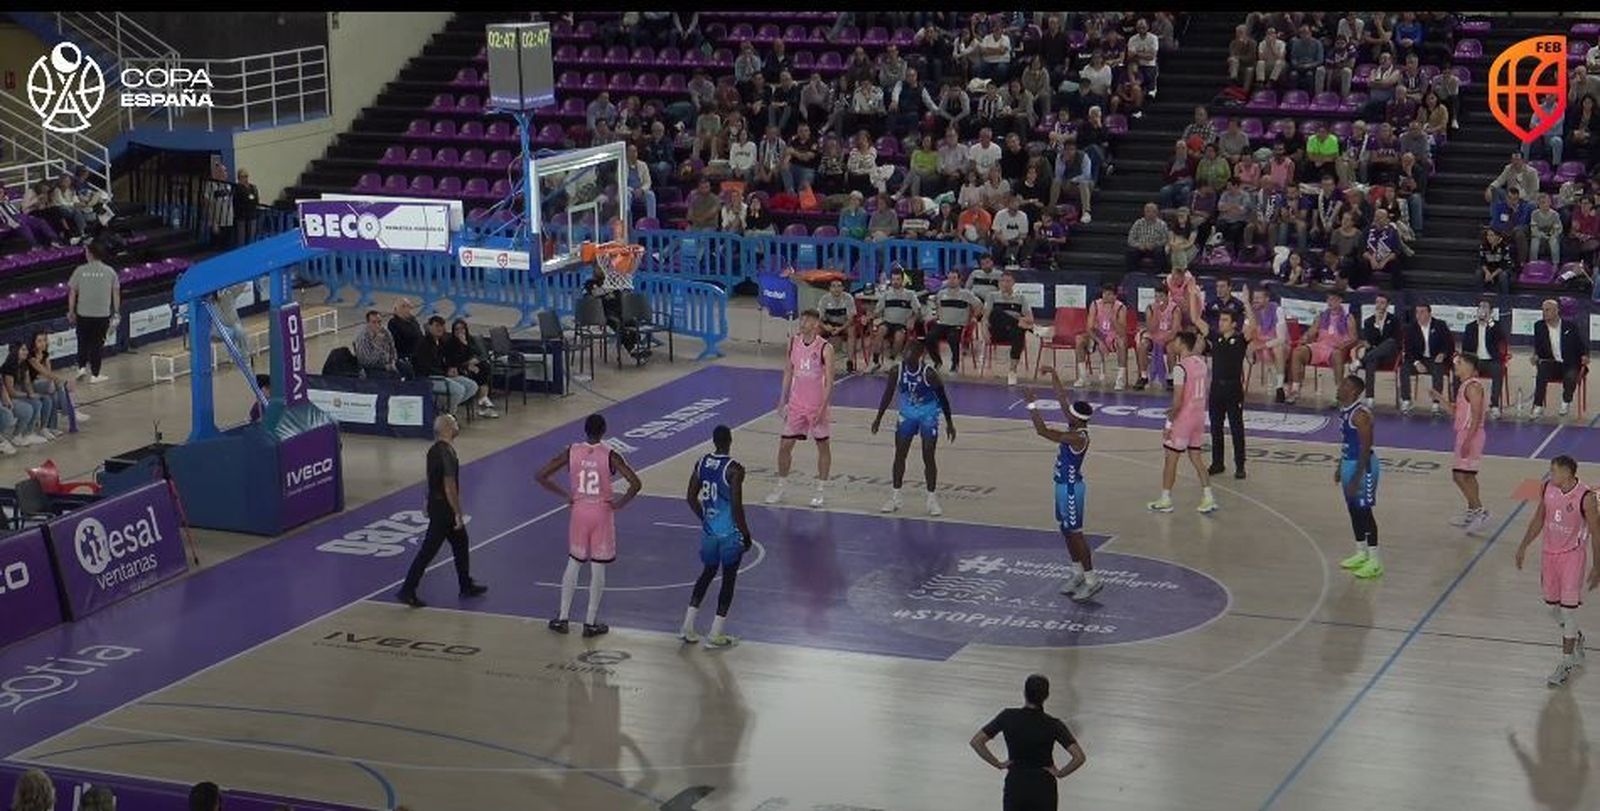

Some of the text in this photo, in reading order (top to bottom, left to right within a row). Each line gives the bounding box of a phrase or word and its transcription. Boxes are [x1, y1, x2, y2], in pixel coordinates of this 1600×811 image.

[488, 31, 516, 48] 02:47
[522, 28, 550, 48] 02:47
[304, 212, 381, 240] BECO
[287, 314, 304, 400] IVECO
[1029, 399, 1169, 419] BCO
[287, 458, 333, 487] IVECO
[577, 470, 600, 495] 12
[702, 481, 718, 501] 80
[96, 553, 158, 590] ventanas
[323, 631, 481, 656] IVECO
